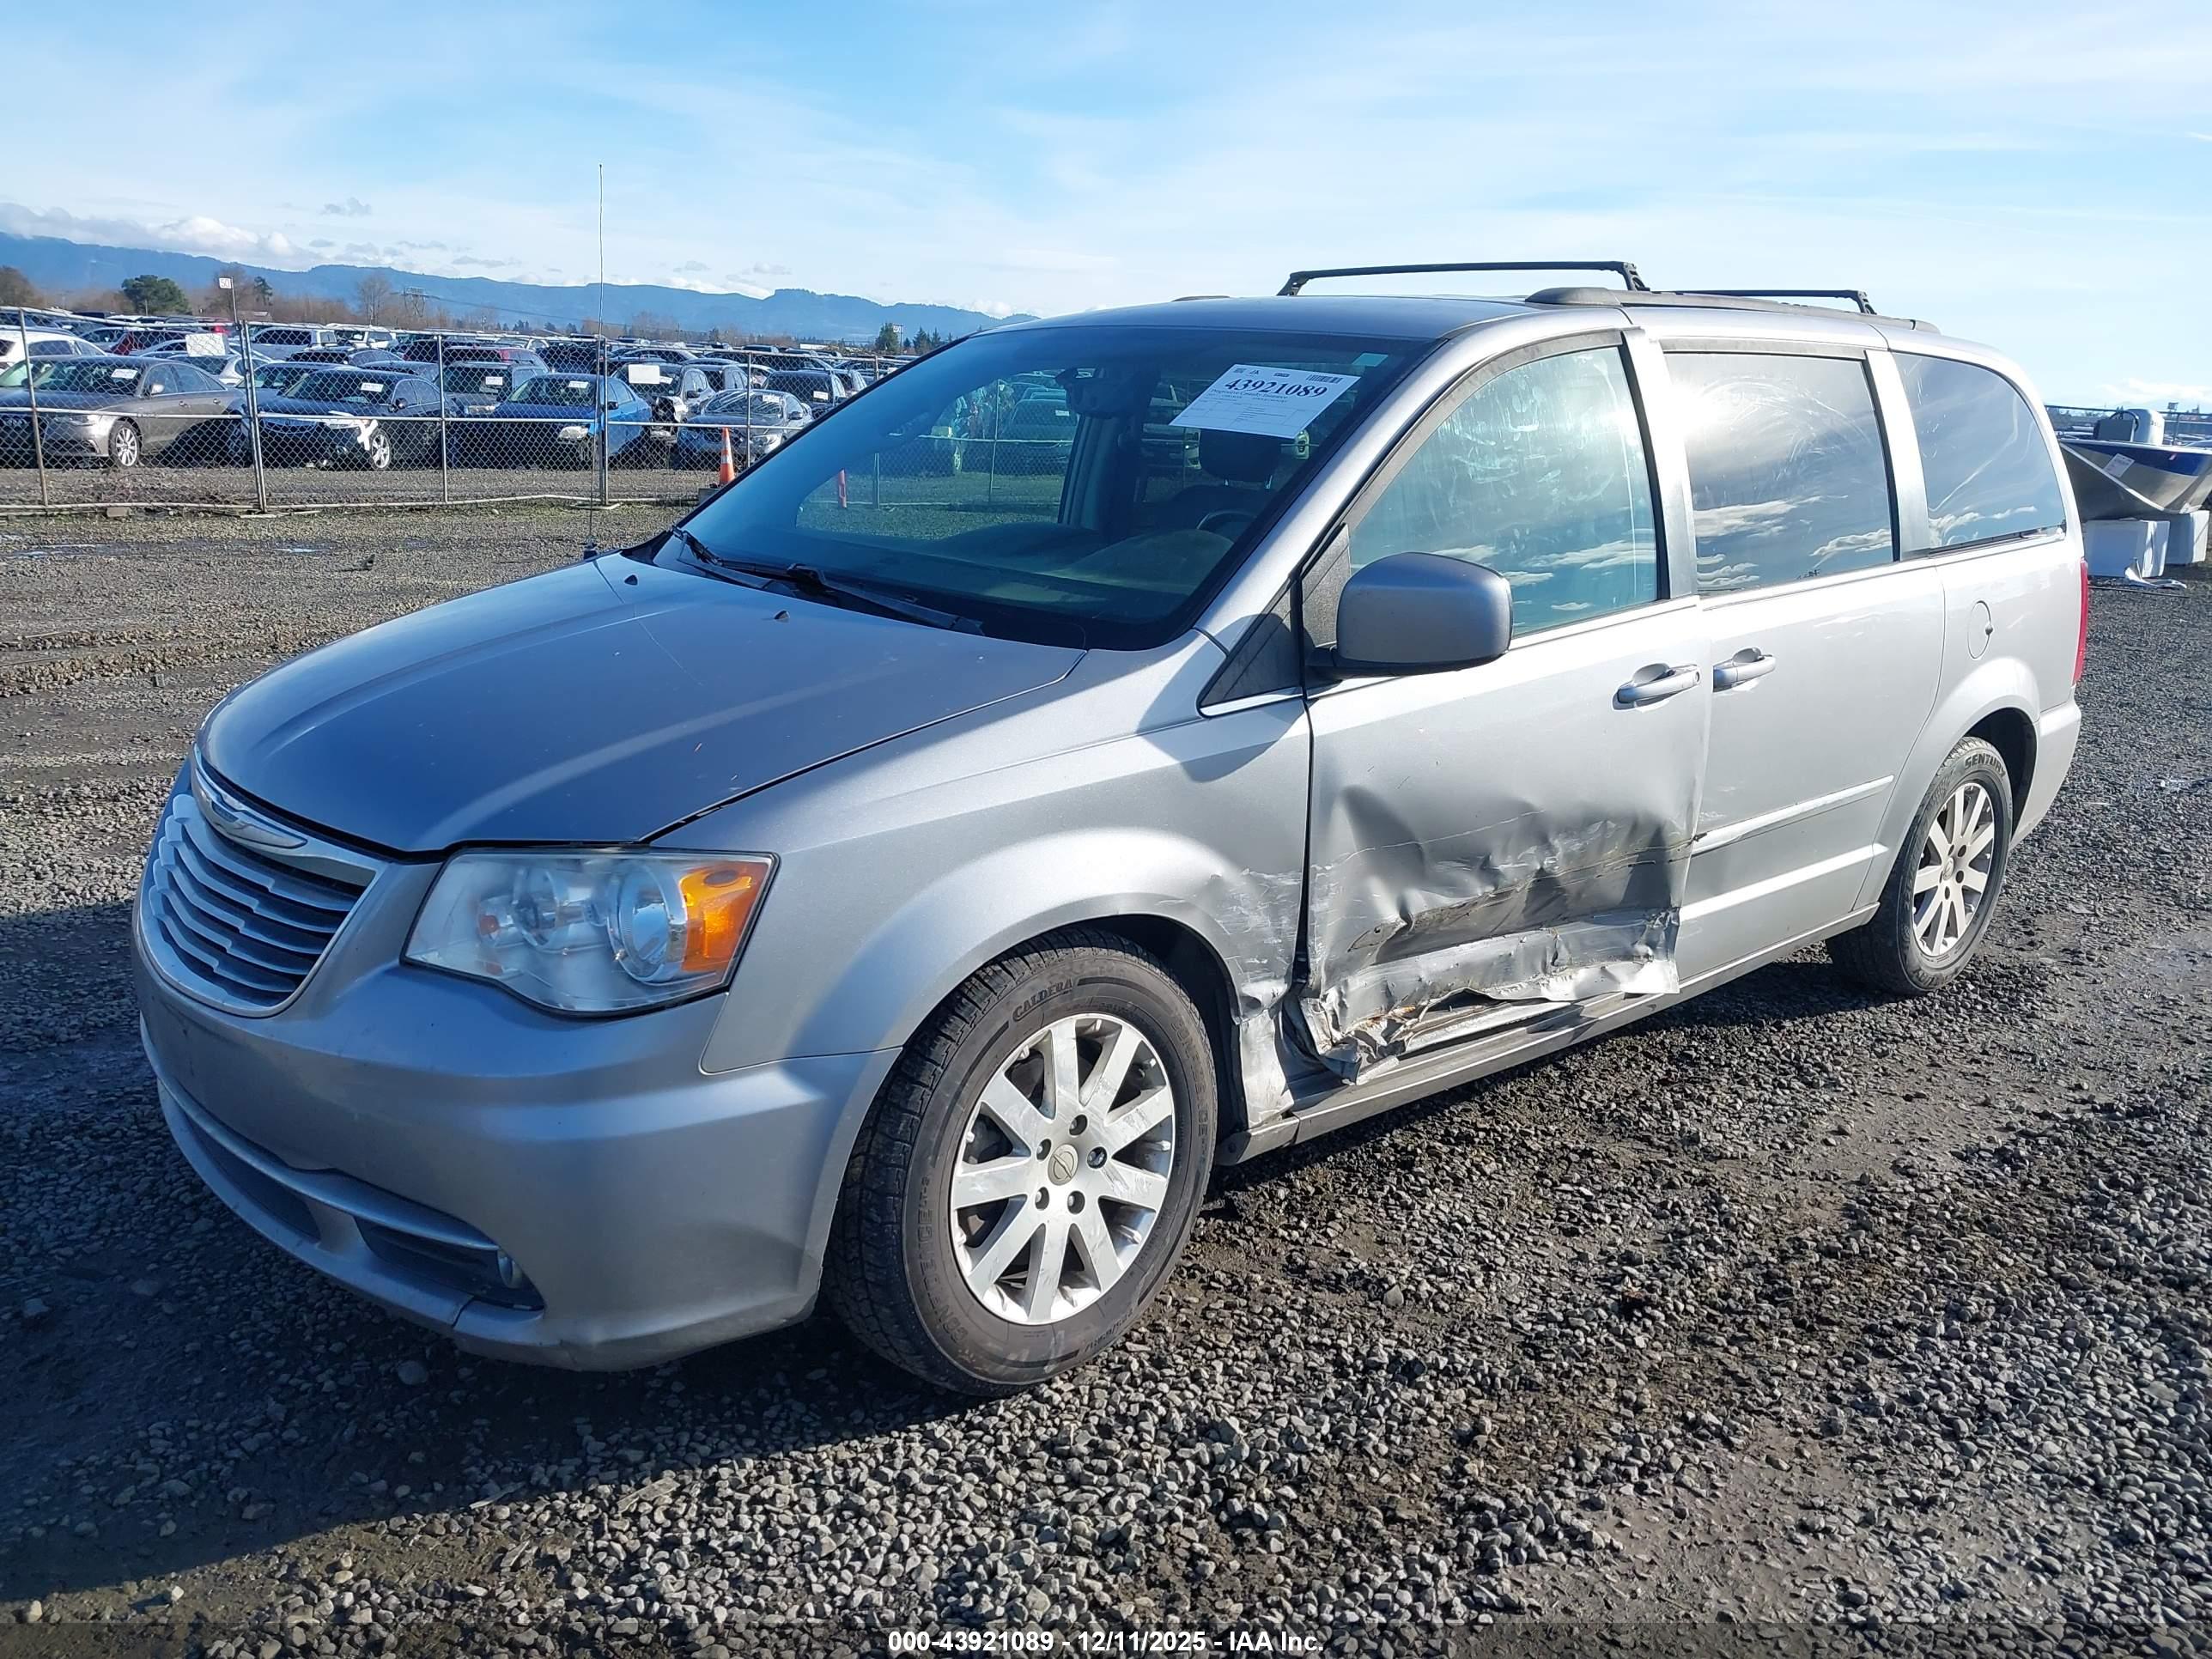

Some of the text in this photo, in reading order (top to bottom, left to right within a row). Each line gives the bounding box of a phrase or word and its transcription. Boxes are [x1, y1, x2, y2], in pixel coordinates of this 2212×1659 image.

[1224, 378, 1328, 398] 43921089
[1965, 753, 2006, 777] SENTURY
[1013, 979, 1072, 1020] CALDERA
